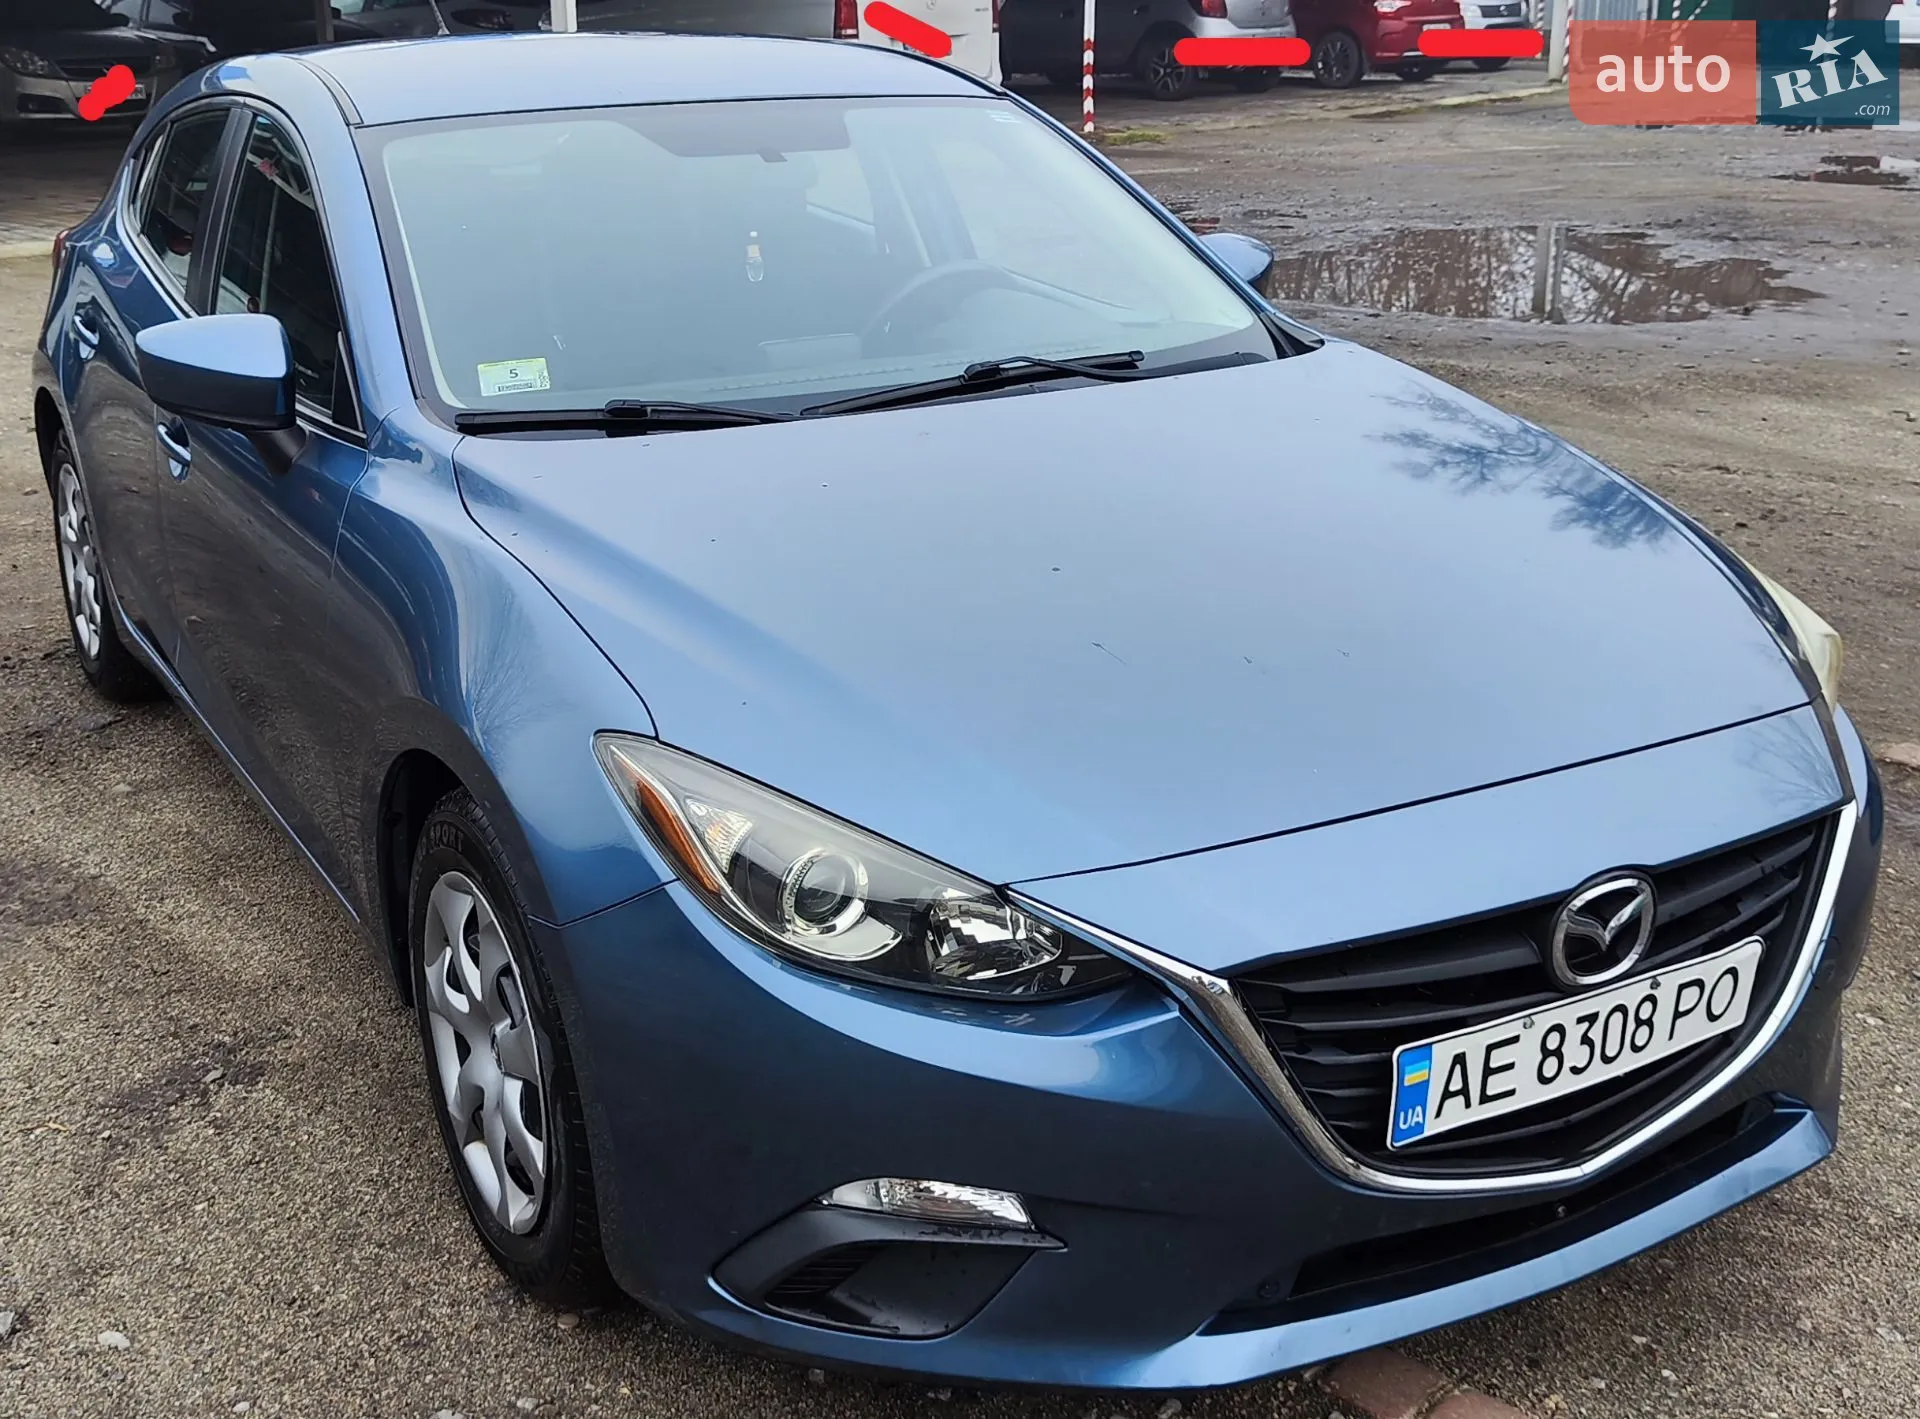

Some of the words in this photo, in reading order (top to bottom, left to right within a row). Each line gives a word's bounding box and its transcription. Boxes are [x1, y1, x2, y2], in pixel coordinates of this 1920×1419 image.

[509, 368, 519, 379] 5
[1434, 1034, 1521, 1119] AE
[1537, 993, 1659, 1086] 8308
[1667, 966, 1739, 1042] PO
[1399, 1105, 1424, 1130] UA
